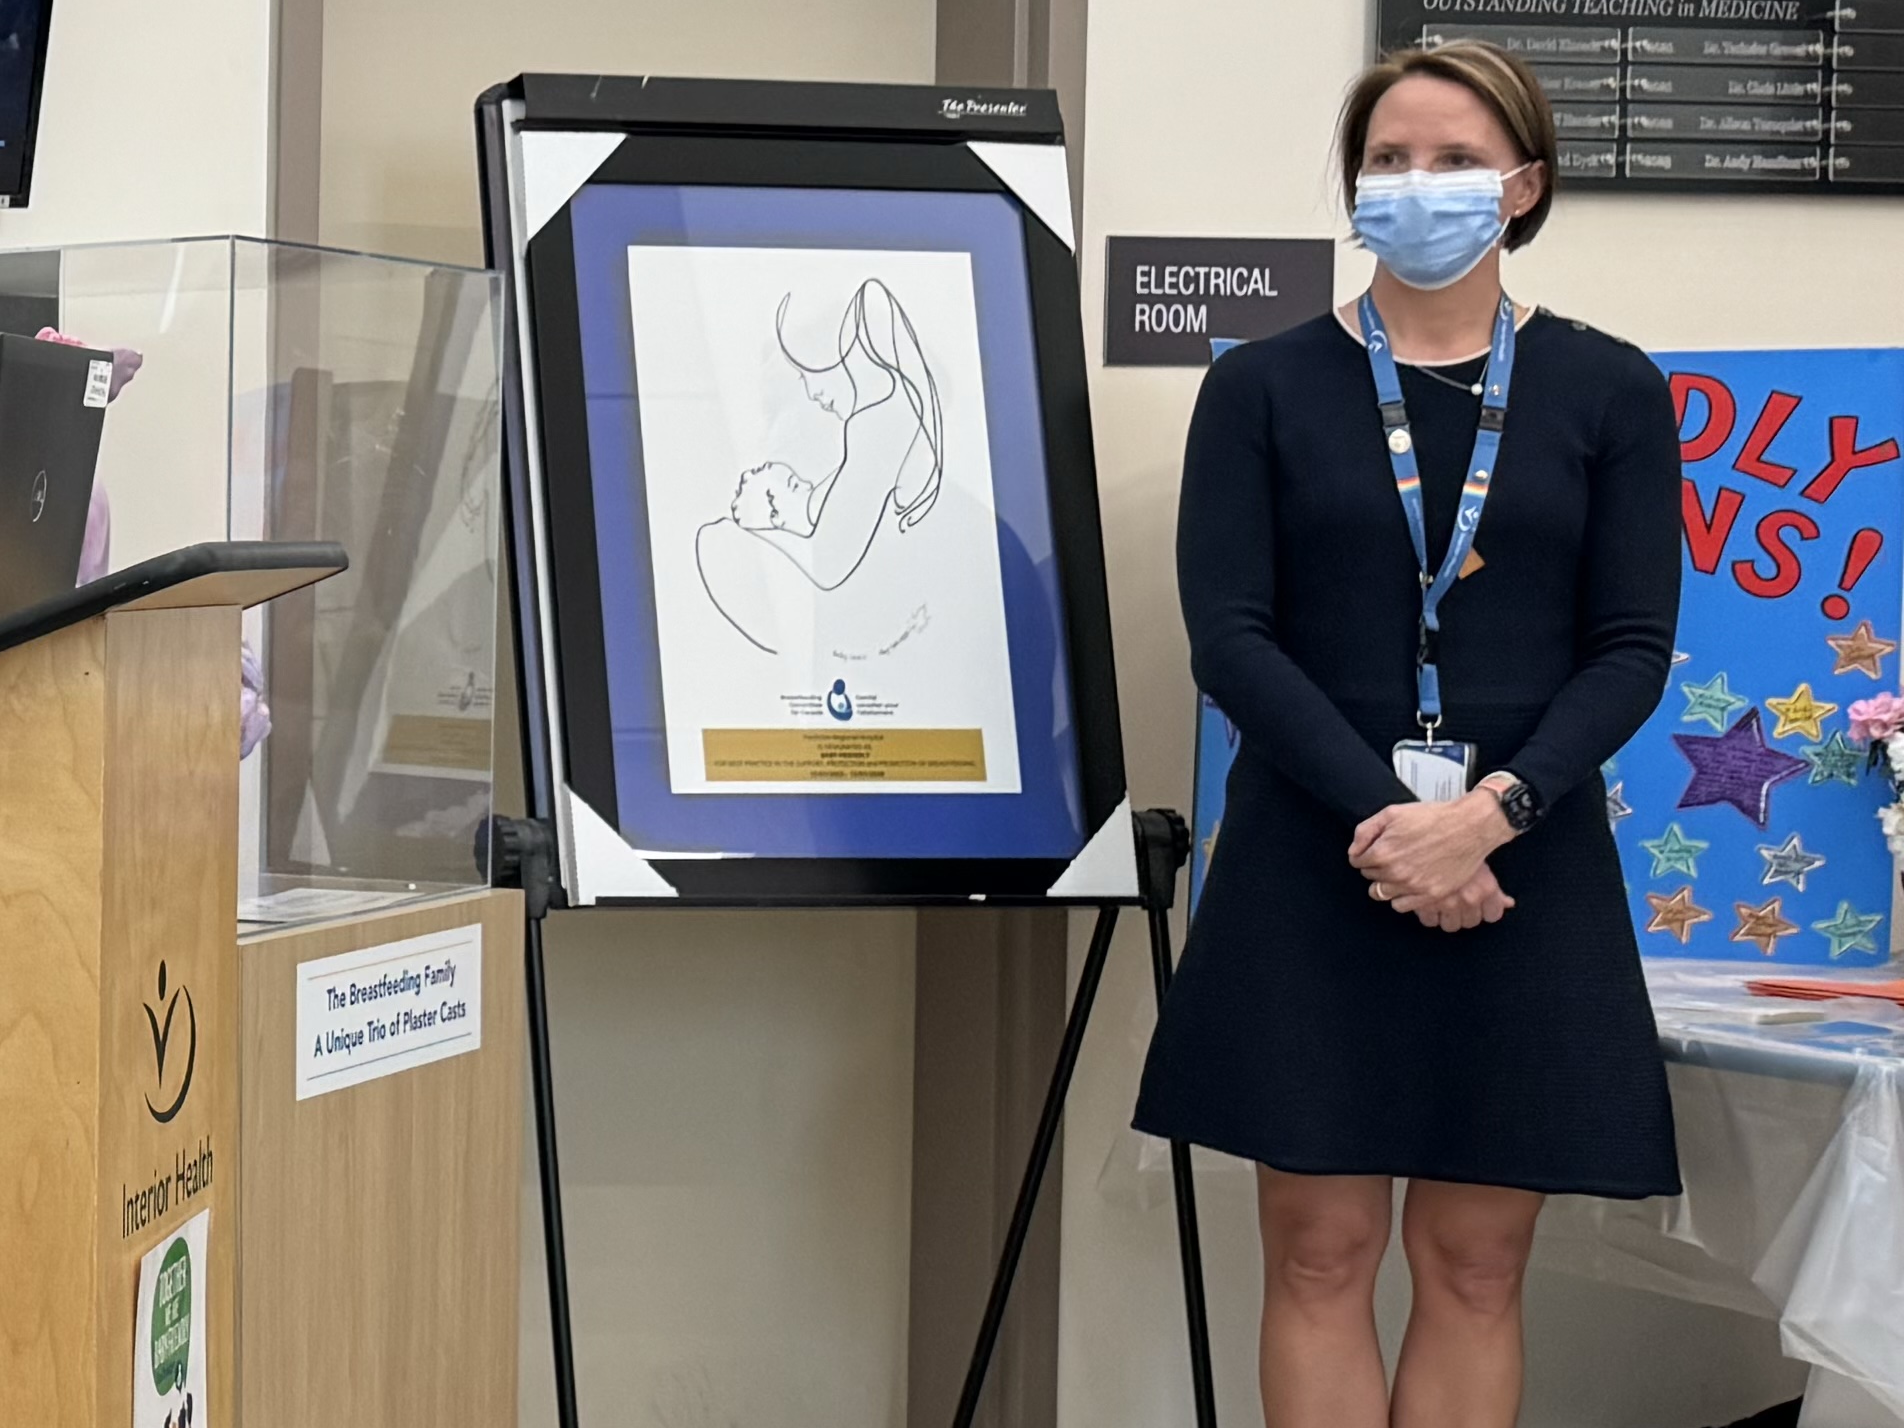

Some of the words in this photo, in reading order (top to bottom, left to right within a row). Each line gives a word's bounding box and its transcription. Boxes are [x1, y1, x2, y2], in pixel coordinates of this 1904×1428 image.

[1135, 265, 1278, 296] ELECTRICAL
[1135, 304, 1207, 333] ROOM
[326, 988, 347, 1012] The
[349, 969, 421, 1006] Breastfeeding
[424, 959, 457, 987] Family
[313, 1035, 324, 1058] A
[326, 1029, 364, 1056] Unique
[367, 1019, 386, 1042] Trio
[389, 1012, 401, 1036] of
[403, 1006, 438, 1032] Plaster
[440, 1000, 467, 1024] Casts
[122, 1169, 172, 1240] Interior
[175, 1135, 214, 1206] Health
